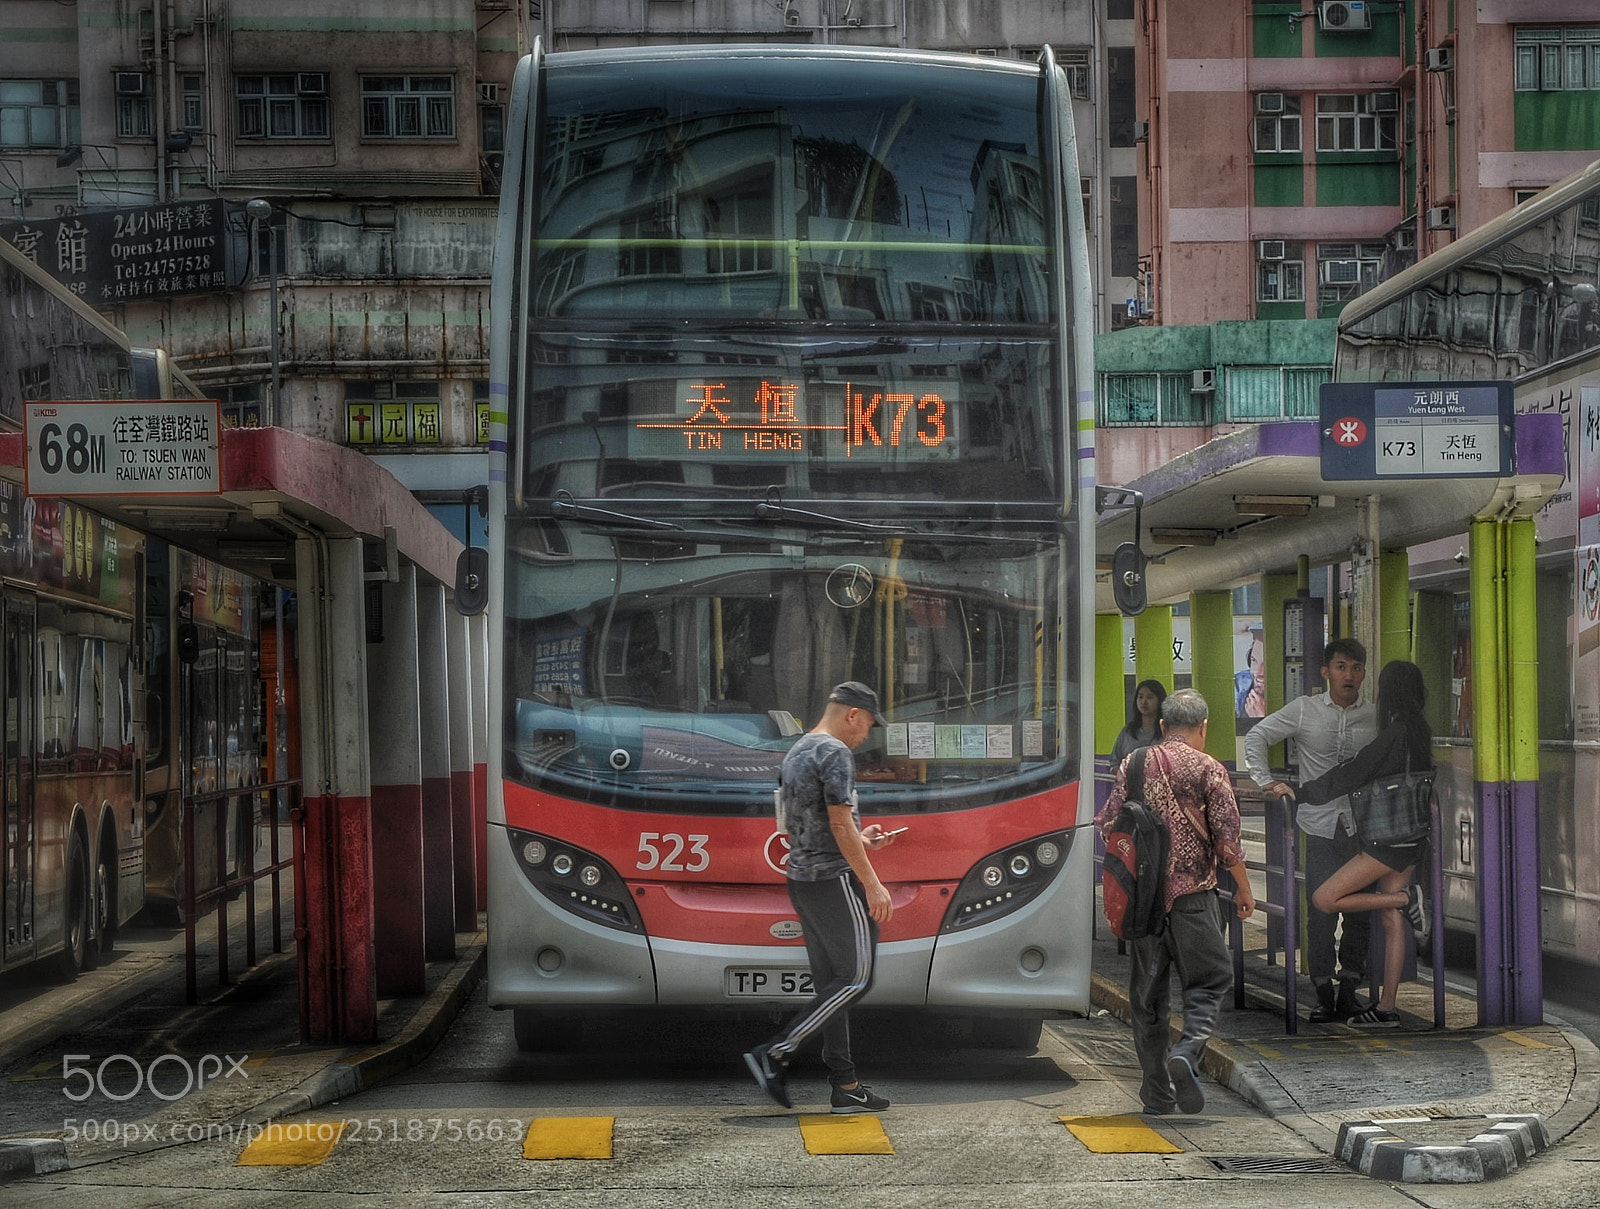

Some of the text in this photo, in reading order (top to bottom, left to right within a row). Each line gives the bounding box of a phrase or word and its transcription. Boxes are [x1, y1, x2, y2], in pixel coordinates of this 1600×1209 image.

[113, 204, 213, 240] 24小時營業
[111, 234, 216, 260] Opens 24 Hours
[114, 254, 211, 280] Tel:24757528
[101, 270, 226, 299] 本店持有效旅業牌照
[1413, 390, 1460, 405] 元朗西
[854, 393, 946, 447] K73
[1408, 405, 1466, 415] Yuen Long West
[112, 414, 209, 444] 往荃灣鐵路站
[385, 408, 436, 439] 元福
[683, 431, 802, 450] TIN HENG
[1382, 441, 1417, 457] K73
[120, 448, 206, 464] TO: TSUEN WAN
[1440, 451, 1482, 462] Tin Heng
[116, 465, 212, 481] RAILWAY STATION
[636, 832, 710, 872] 523
[734, 972, 767, 993] TP
